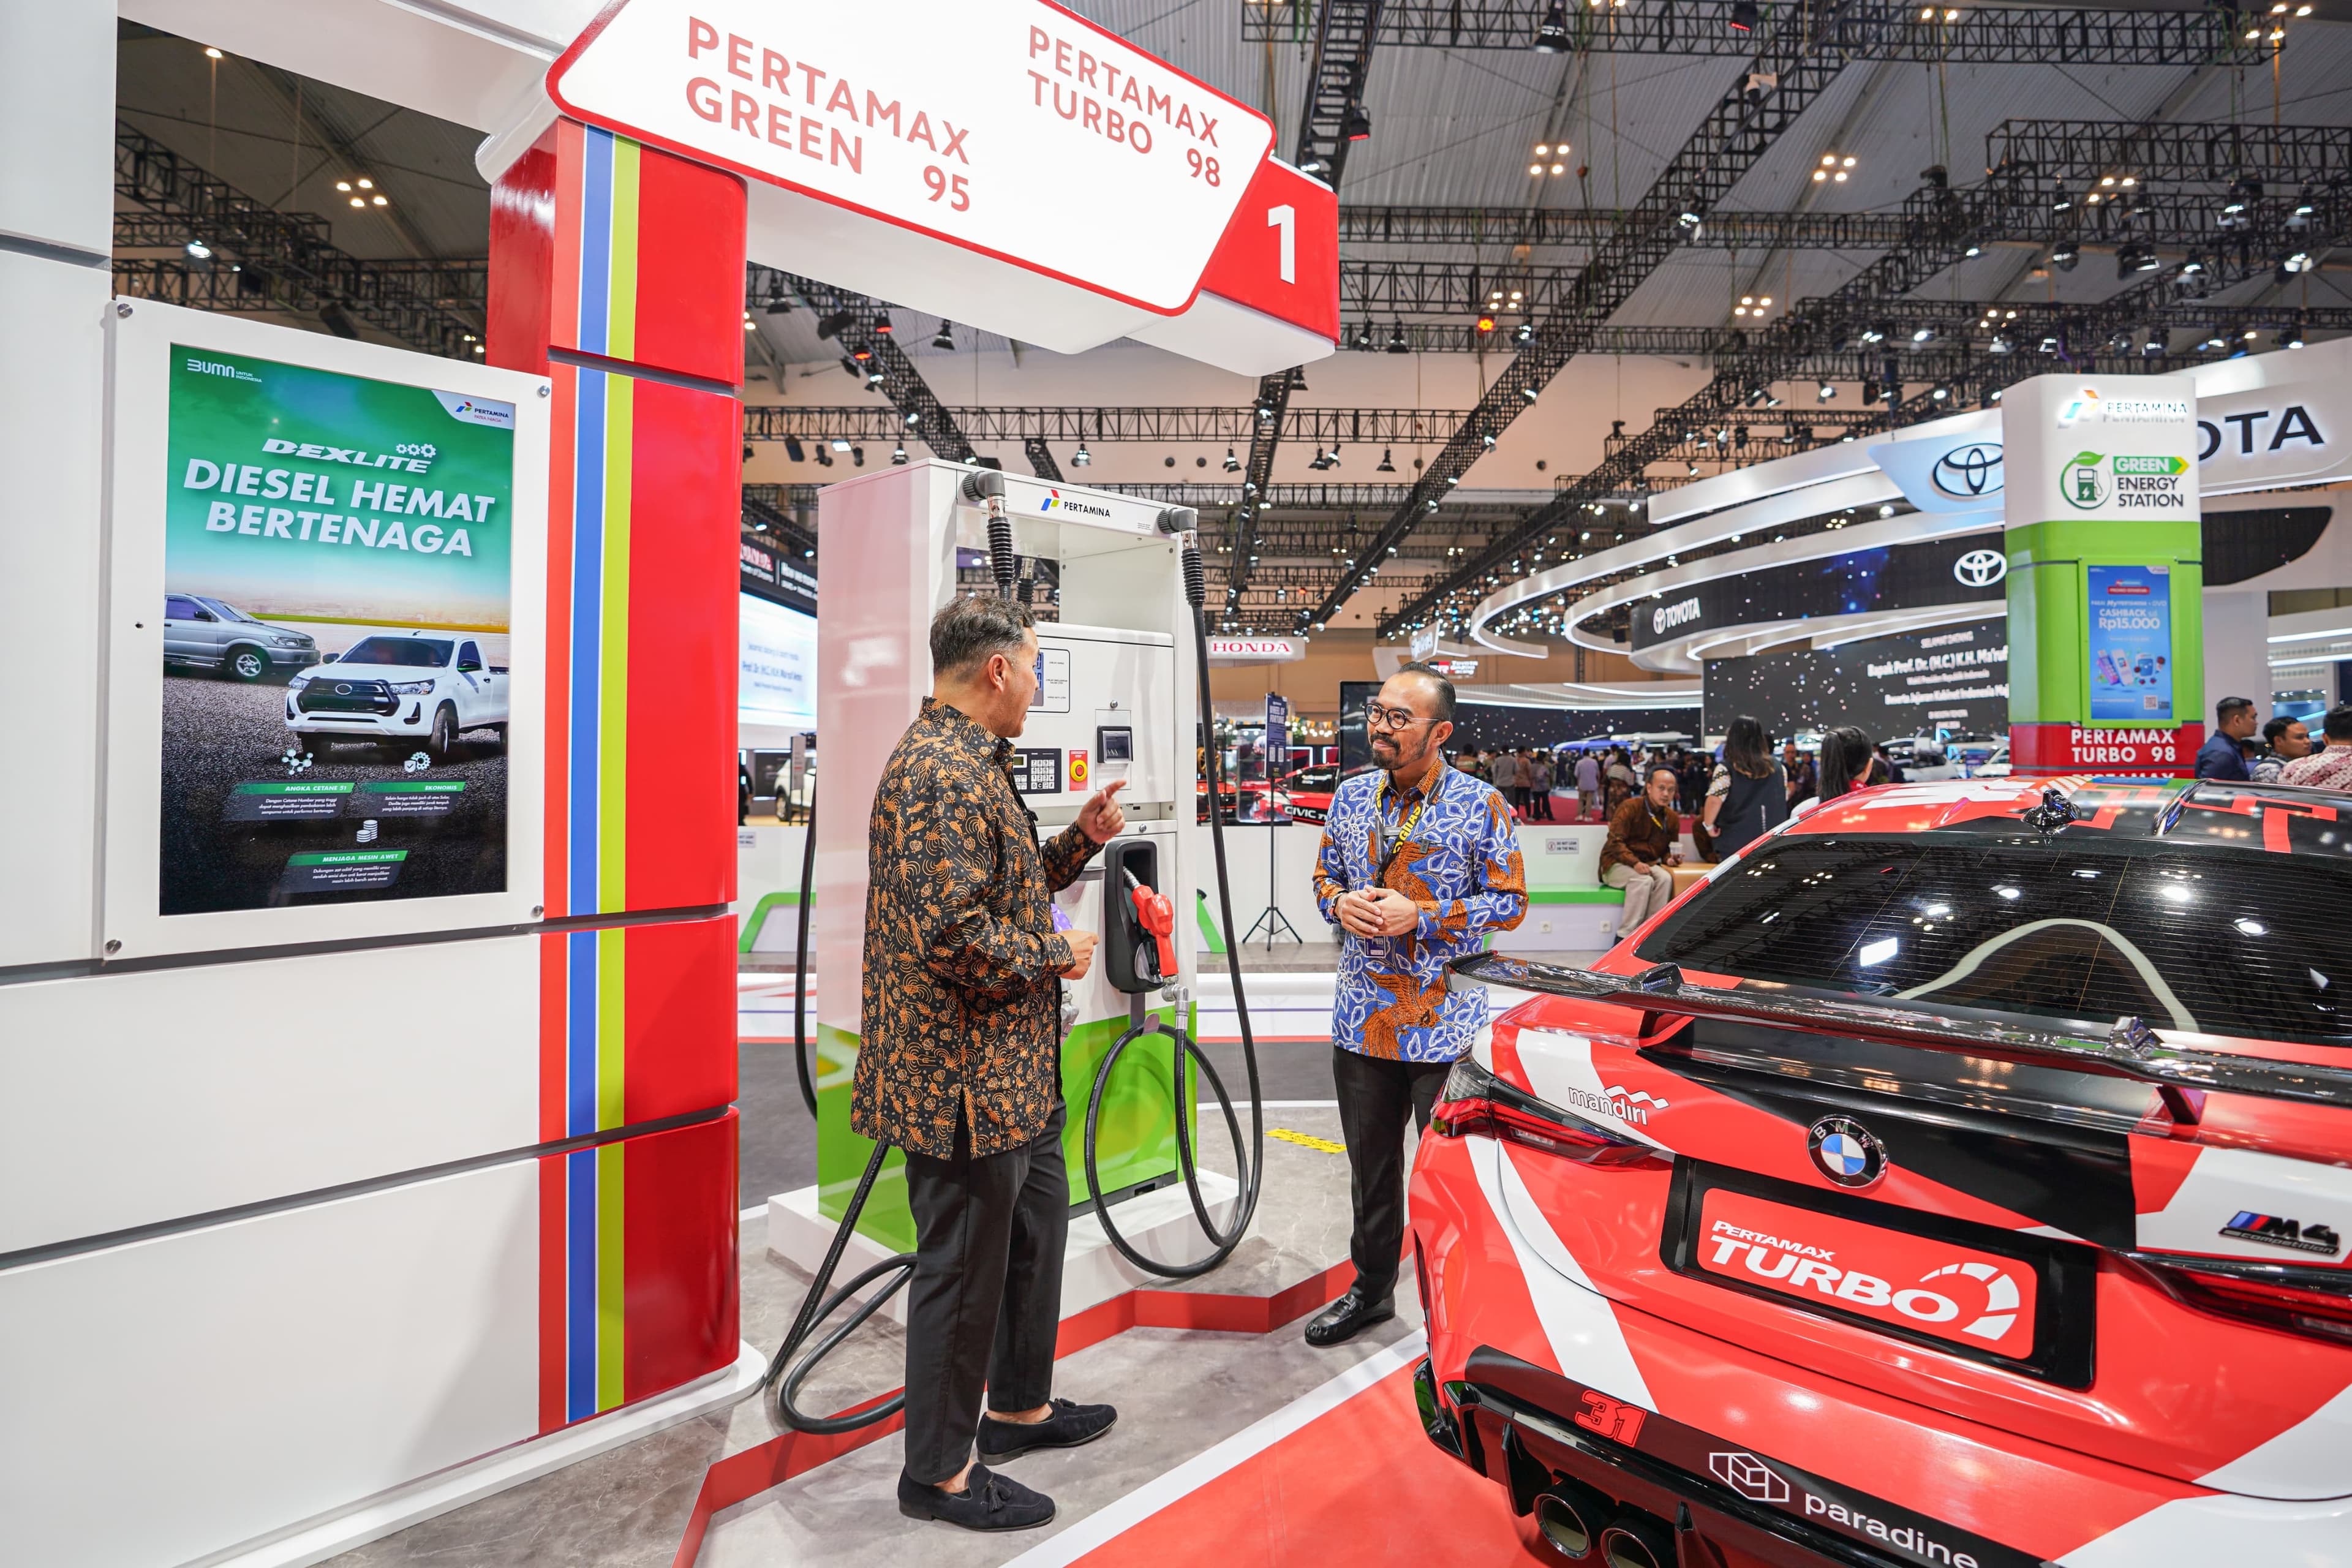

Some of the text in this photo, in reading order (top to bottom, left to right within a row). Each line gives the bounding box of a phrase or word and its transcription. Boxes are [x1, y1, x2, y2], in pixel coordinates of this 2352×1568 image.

[688, 16, 970, 165] PERTAMAX
[1029, 24, 1218, 148] PERTAMAX
[686, 77, 862, 175] GREEN
[1027, 69, 1153, 154] TURBO
[1186, 148, 1221, 188] 98
[922, 165, 971, 212] 95
[1268, 204, 1295, 285] 1
[475, 408, 509, 418] PERTAMINA
[2108, 402, 2187, 413] PERTAMINA
[262, 438, 432, 474] DEXLITE
[2116, 458, 2170, 472] GREEN
[184, 458, 496, 523] DIESEL HEMAT
[2117, 477, 2179, 491] ENERGY
[1064, 501, 1111, 518] PERTAMINA
[2118, 494, 2184, 507] STATION
[205, 501, 473, 557] BERTENAGA
[1665, 597, 1701, 628] TOYOTA
[2098, 617, 2160, 631] Rp15.000
[2099, 608, 2146, 617] CASHBACK
[1213, 643, 1290, 652] HONDA
[2071, 729, 2174, 745] PERTAMAX
[2071, 746, 2176, 763] TURBO 98
[1284, 805, 1317, 819] CIVIC
[1568, 1087, 1648, 1126] mandiri
[1814, 1121, 1874, 1148] BMW
[1712, 1220, 1836, 1262] PERTAMAX
[2241, 1232, 2334, 1254] competition
[2255, 1216, 2339, 1246] M4
[1710, 1234, 1959, 1322] TURBO
[1575, 1390, 1648, 1448] 31
[1804, 1491, 1978, 1568] paradine
